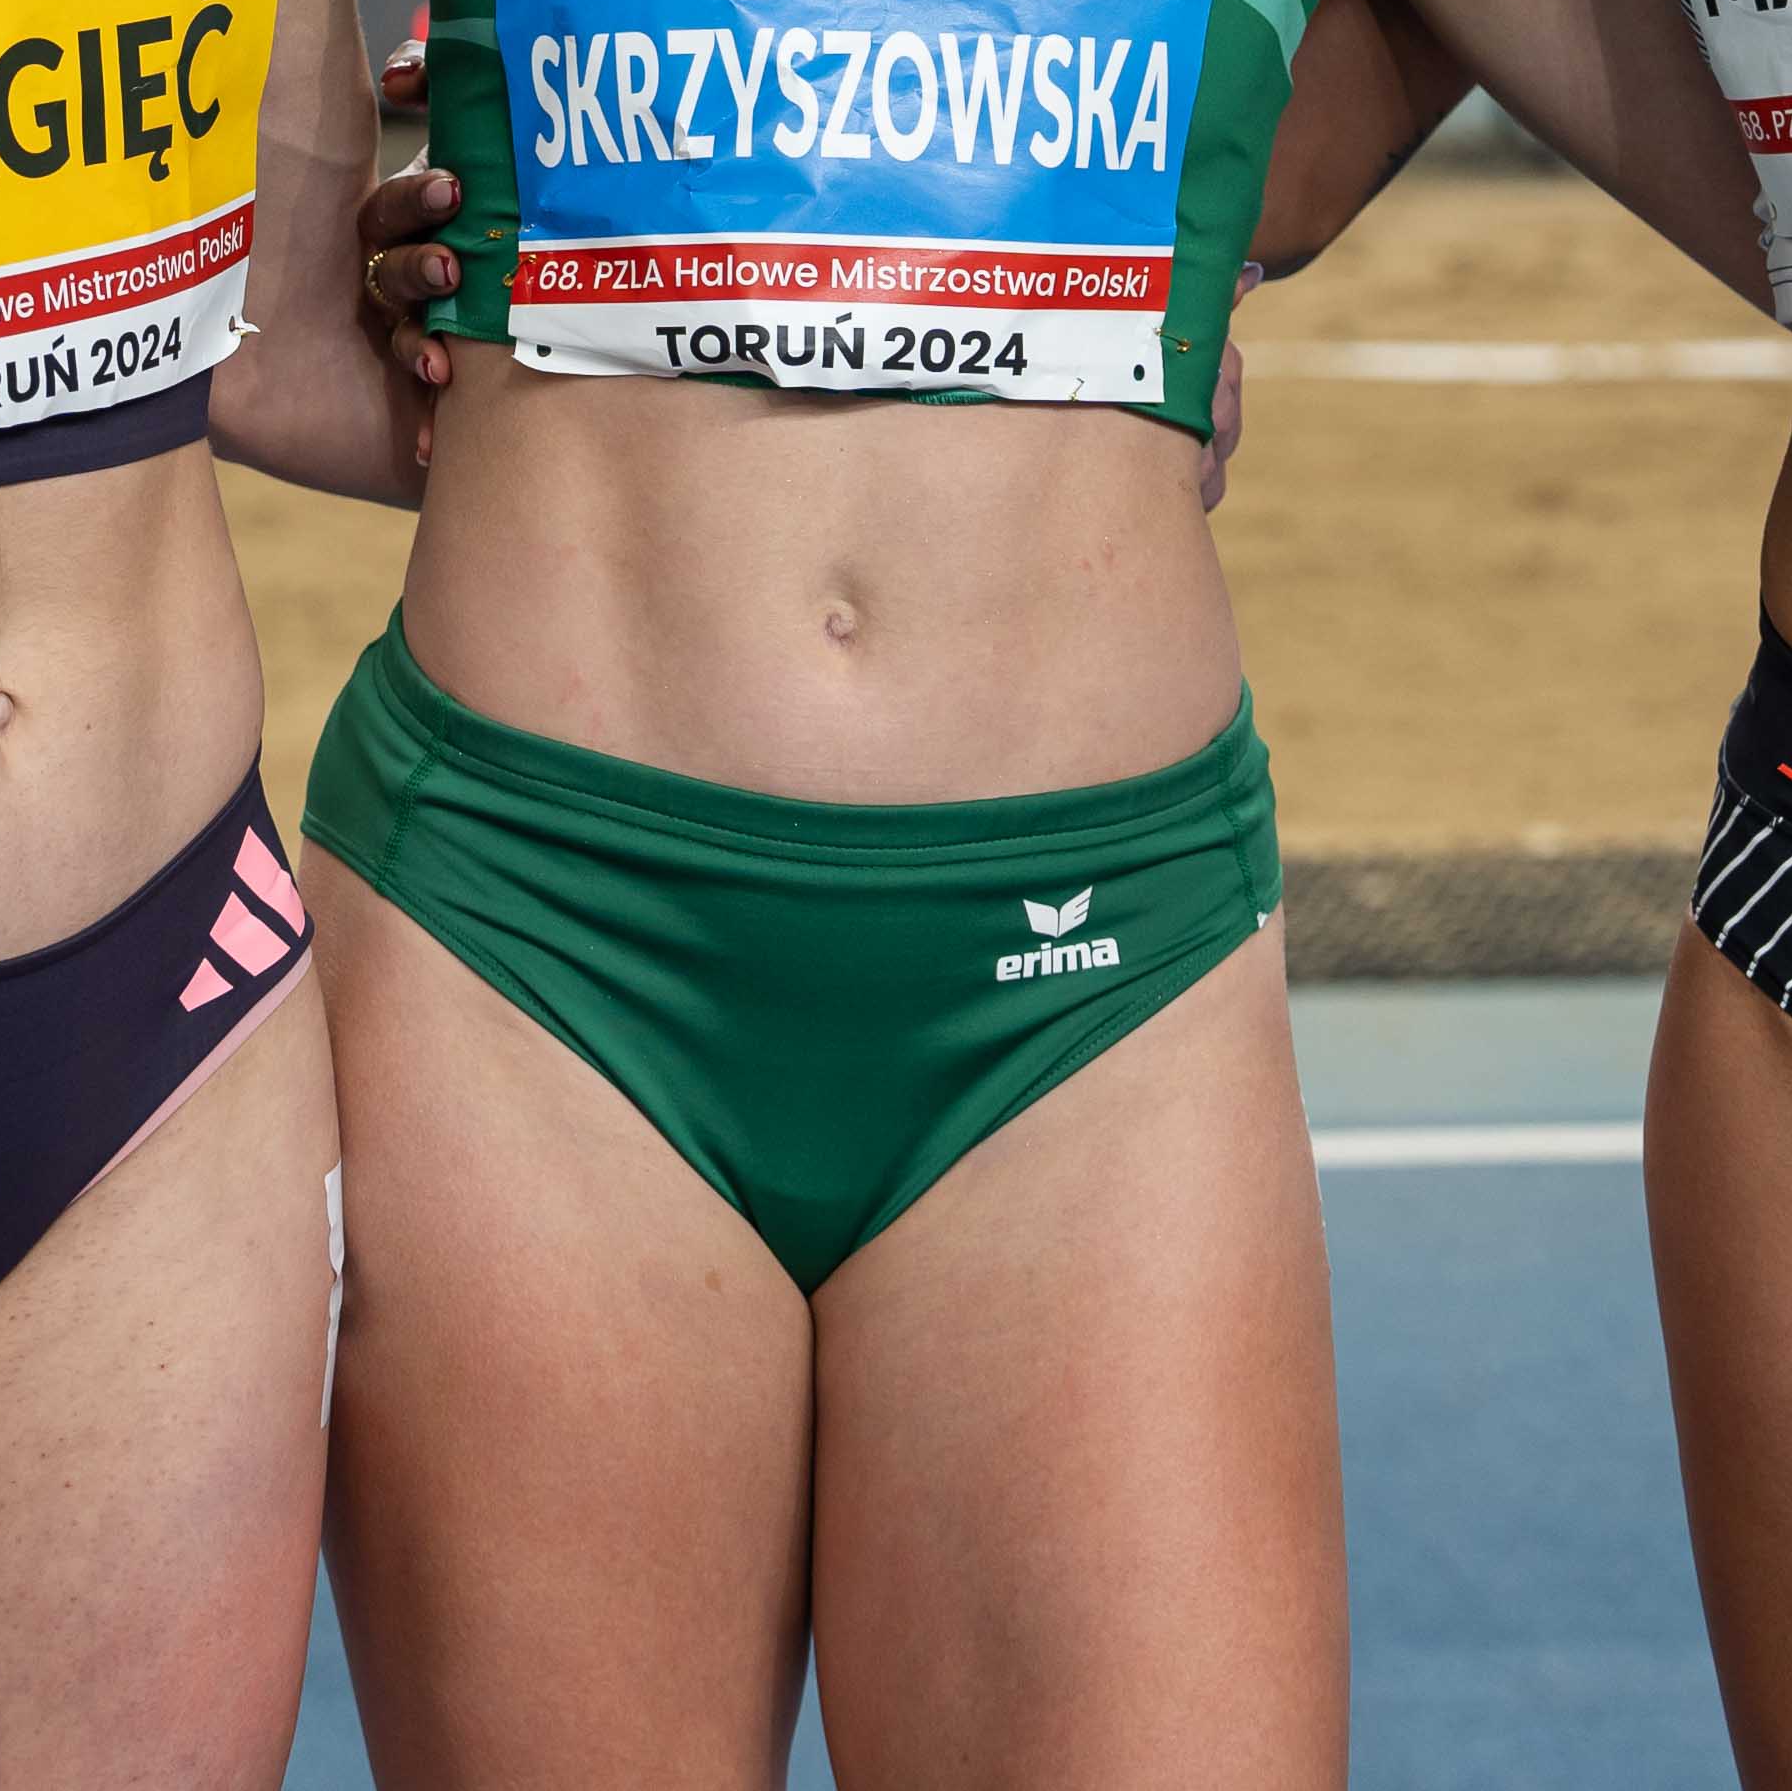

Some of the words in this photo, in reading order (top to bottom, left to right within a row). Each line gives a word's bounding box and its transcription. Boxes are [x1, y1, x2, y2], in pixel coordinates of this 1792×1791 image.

[530, 26, 1170, 173] SKRZYSZOWSKA
[1740, 109, 1770, 141] 68.
[42, 249, 196, 313] Mistrzostwa
[199, 221, 245, 270] Polski
[538, 259, 583, 291] 68.
[593, 258, 664, 290] PZLA
[675, 256, 818, 289] Halowe
[831, 258, 1056, 297] Mistrzostwa
[1063, 265, 1150, 299] Polski
[91, 317, 182, 388] 2024
[656, 311, 865, 371] TORUŃ
[882, 328, 1028, 377] 2024
[996, 937, 1121, 982] erima
